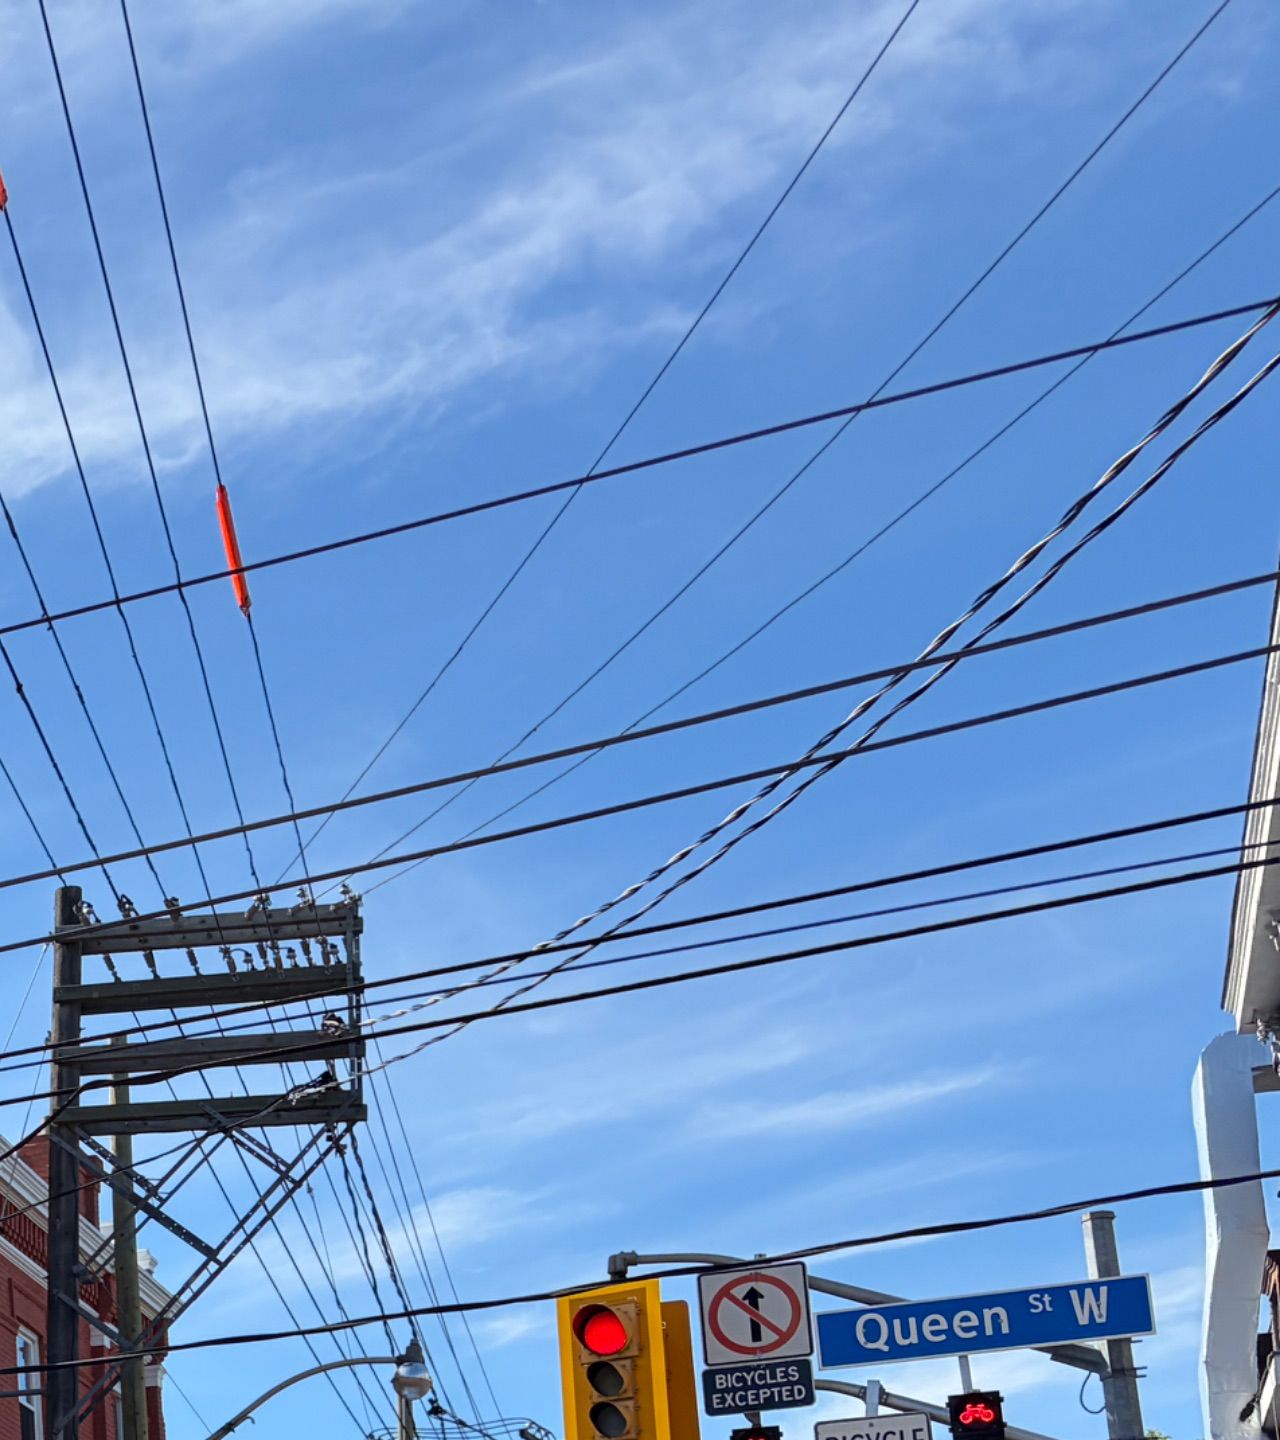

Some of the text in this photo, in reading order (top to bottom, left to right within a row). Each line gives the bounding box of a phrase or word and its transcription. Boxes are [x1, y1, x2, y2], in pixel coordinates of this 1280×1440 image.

[855, 1286, 1108, 1352] Queen St W
[715, 1366, 800, 1389] BICYCLES
[712, 1385, 806, 1409] EXCEPTED
